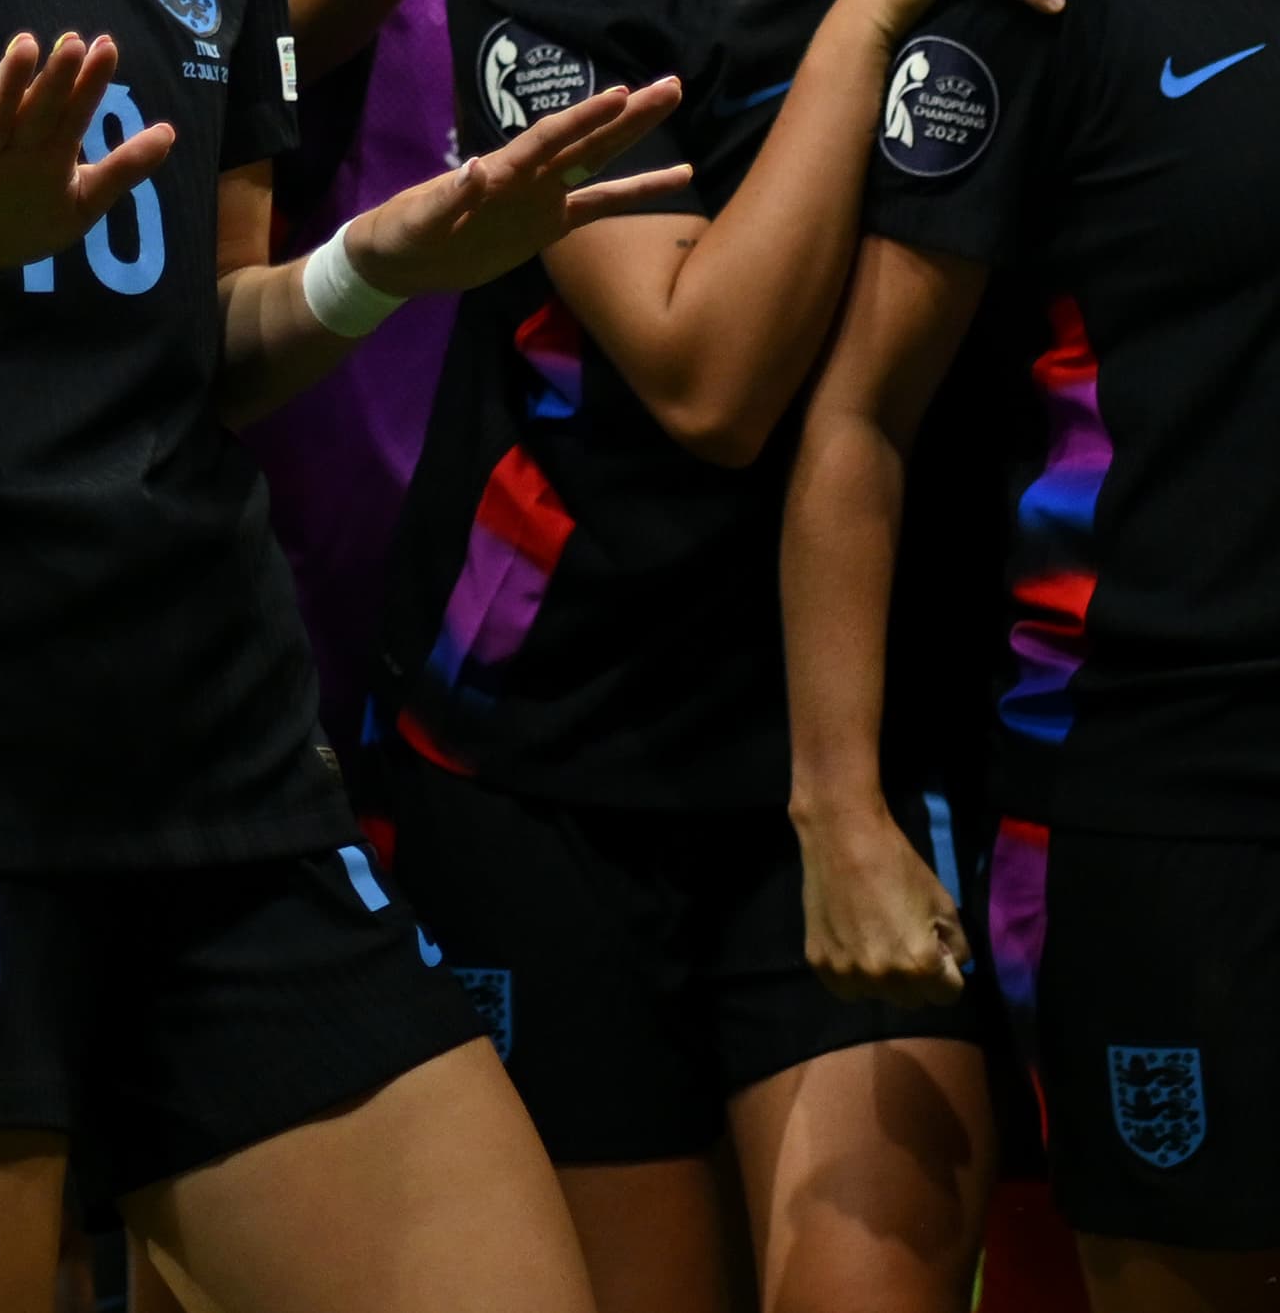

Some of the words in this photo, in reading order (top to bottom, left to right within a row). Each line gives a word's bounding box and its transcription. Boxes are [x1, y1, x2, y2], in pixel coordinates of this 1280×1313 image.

[183, 61, 197, 78] 22
[516, 63, 580, 83] EUROPEAN
[515, 75, 584, 96] CHAMPIONS
[531, 92, 570, 111] 2022
[918, 92, 986, 116] EUROPEAN
[913, 105, 986, 129] CHAMPIONS
[924, 124, 968, 144] 2022
[22, 83, 166, 296] 8
